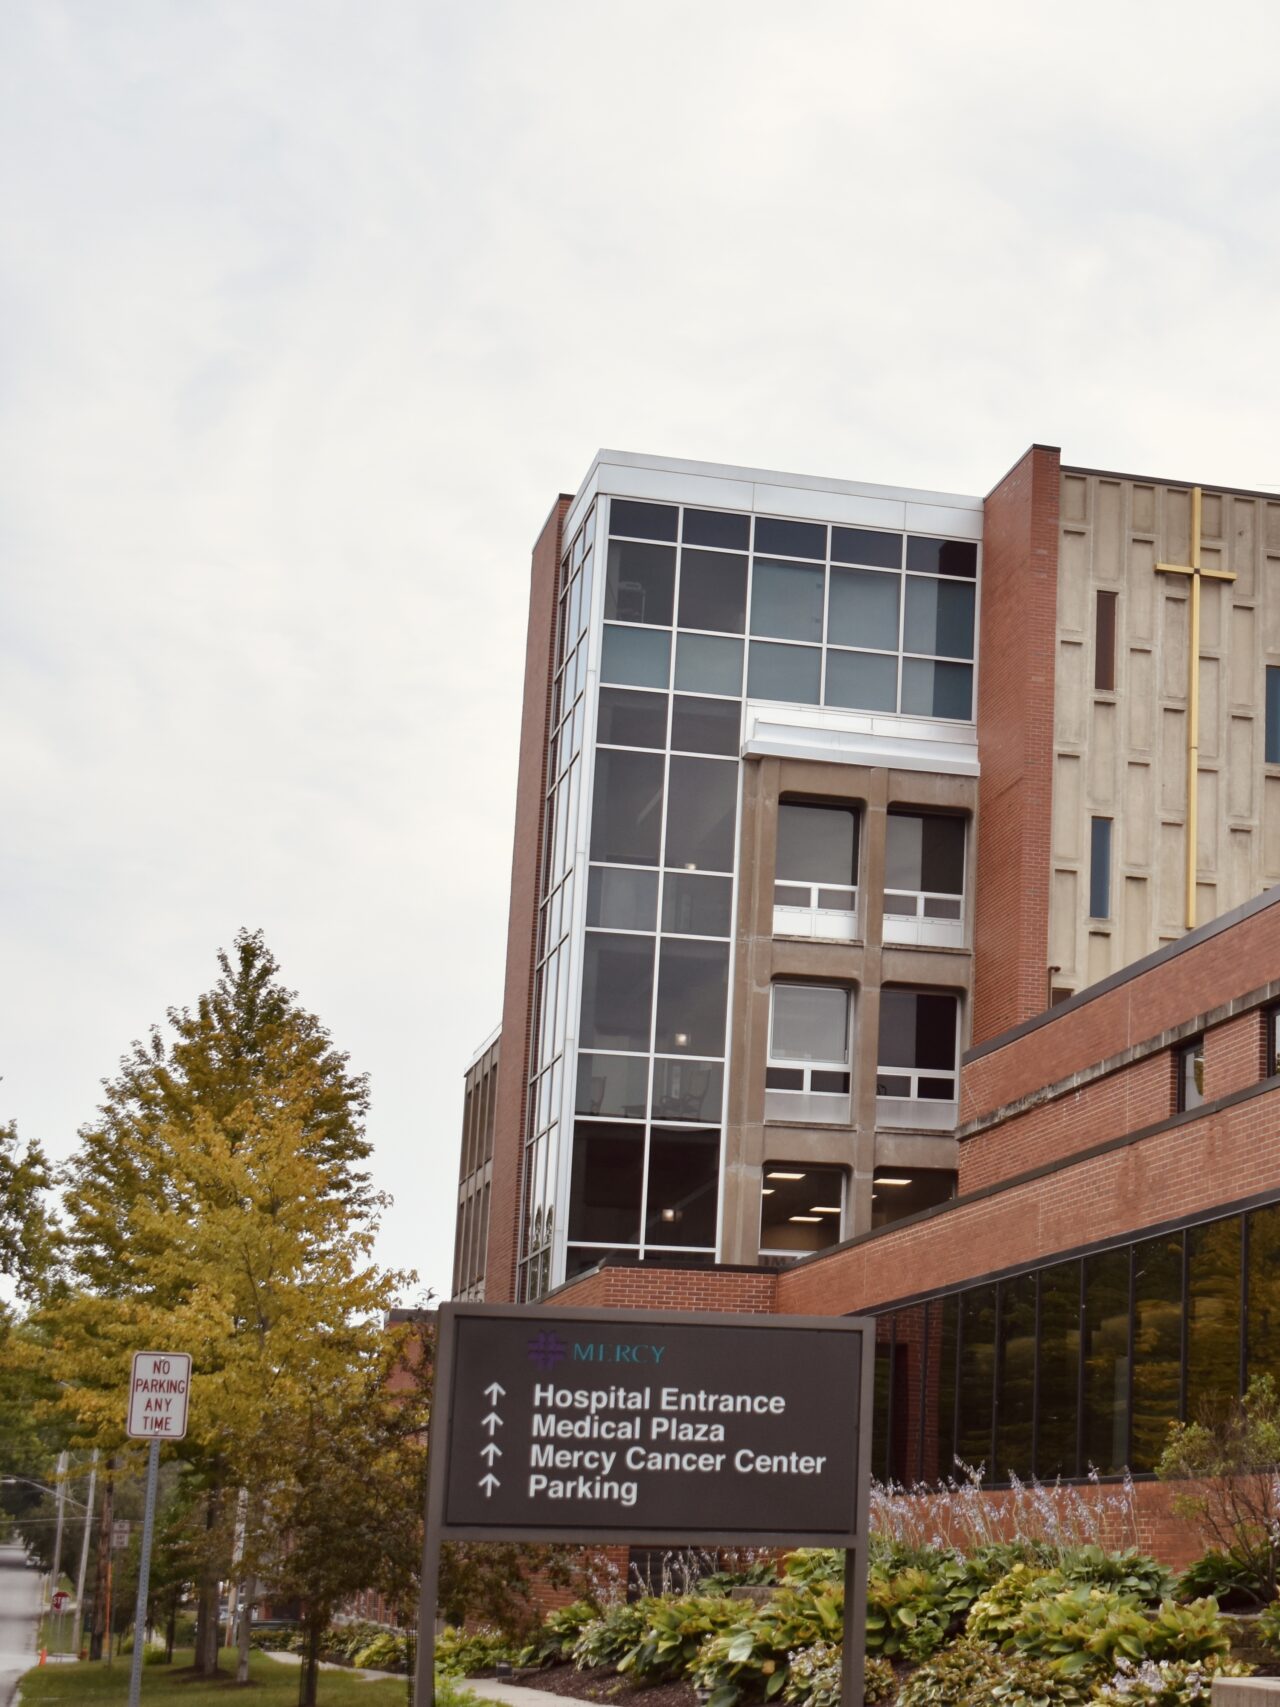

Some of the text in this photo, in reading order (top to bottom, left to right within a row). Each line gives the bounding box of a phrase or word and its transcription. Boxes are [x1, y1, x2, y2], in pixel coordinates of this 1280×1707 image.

[573, 1343, 666, 1364] MERCY
[152, 1360, 171, 1375] NO
[135, 1378, 186, 1394] PARKING
[144, 1398, 172, 1412] ANY
[533, 1383, 786, 1414] Hospital Entrance
[143, 1416, 172, 1431] TIME
[532, 1413, 725, 1442] Medical Plaza
[530, 1443, 828, 1474] Mercy Cancer Center
[528, 1474, 638, 1507] Parking
